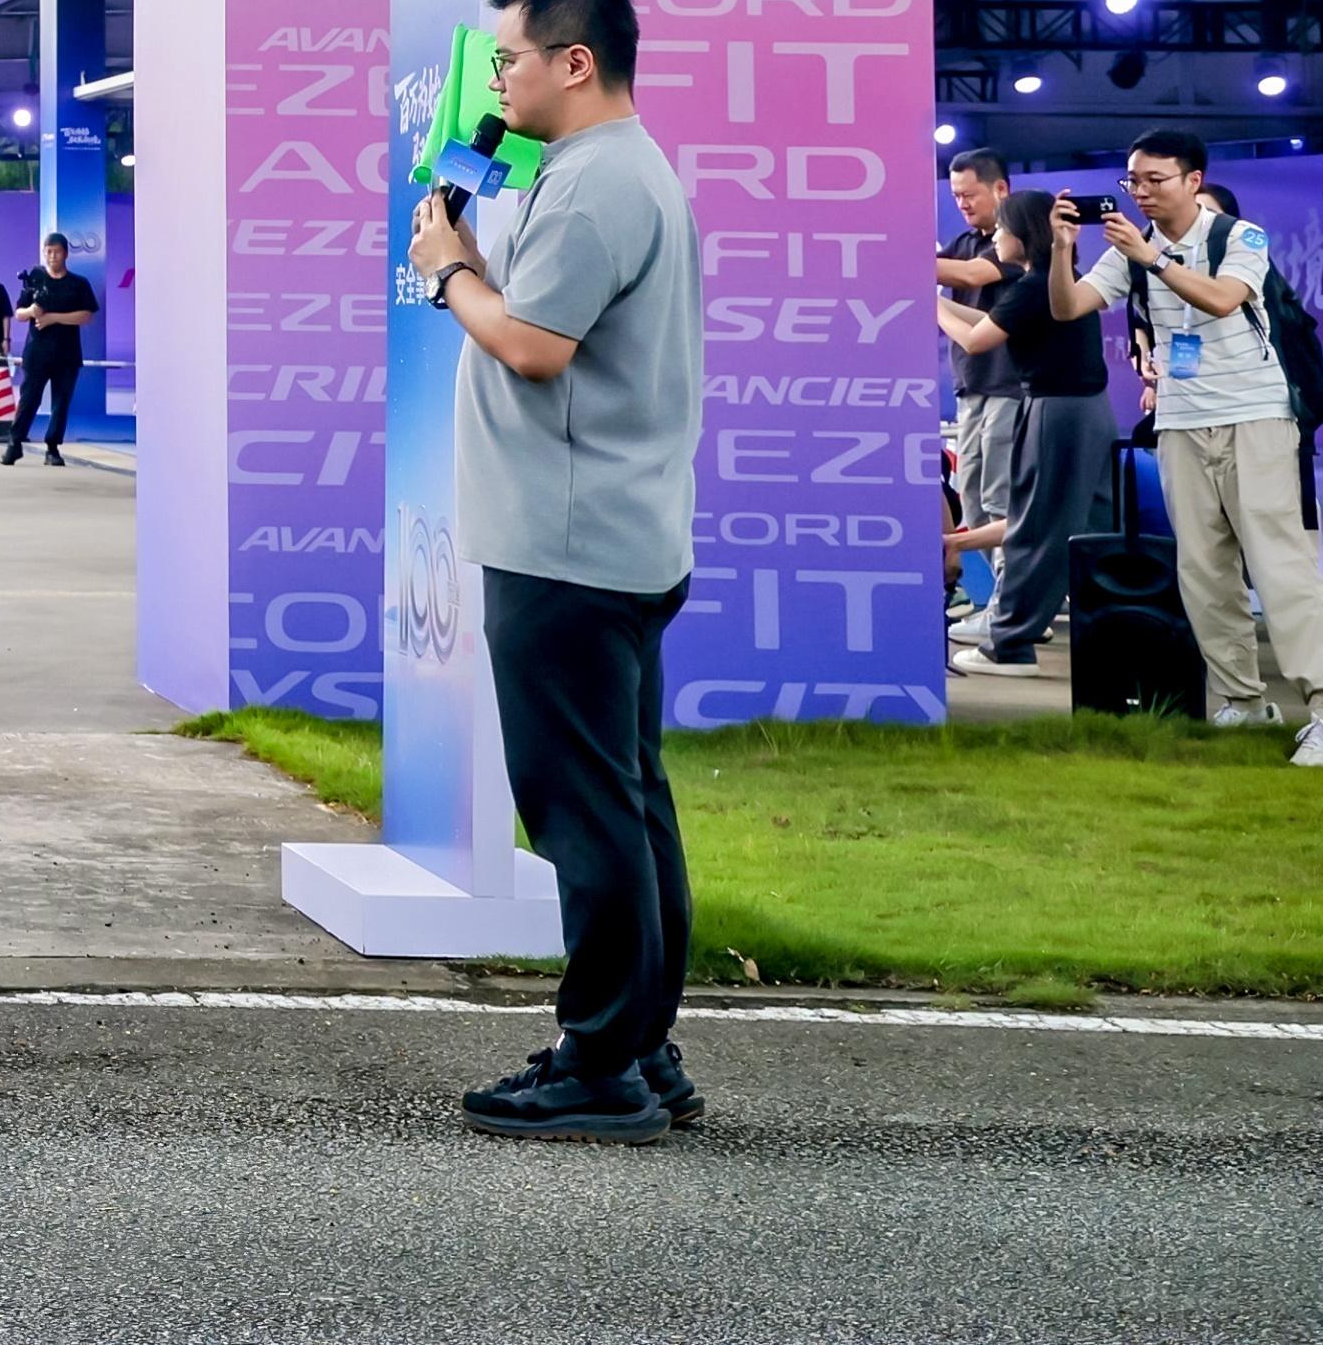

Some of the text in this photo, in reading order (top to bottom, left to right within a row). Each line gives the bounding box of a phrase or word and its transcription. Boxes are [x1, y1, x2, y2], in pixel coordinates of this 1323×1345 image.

[703, 231, 889, 279] FIT
[1244, 231, 1265, 246] 25
[227, 365, 936, 408] CRI ANCIER
[228, 430, 386, 487] CI
